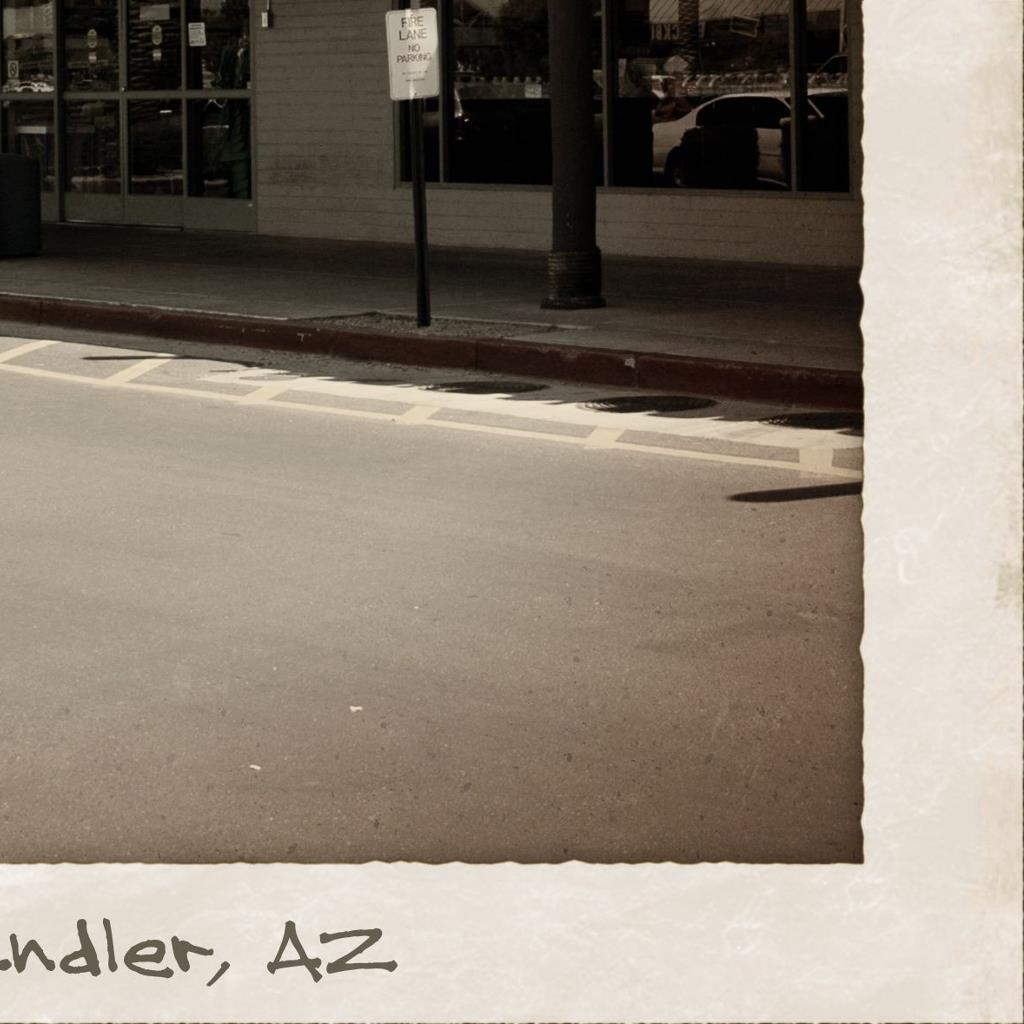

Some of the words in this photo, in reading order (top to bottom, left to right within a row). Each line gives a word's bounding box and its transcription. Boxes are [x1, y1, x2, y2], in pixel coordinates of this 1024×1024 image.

[401, 15, 424, 28] FIRE
[399, 28, 427, 41] LANE
[408, 43, 421, 52] NO
[397, 52, 432, 63] PARKING
